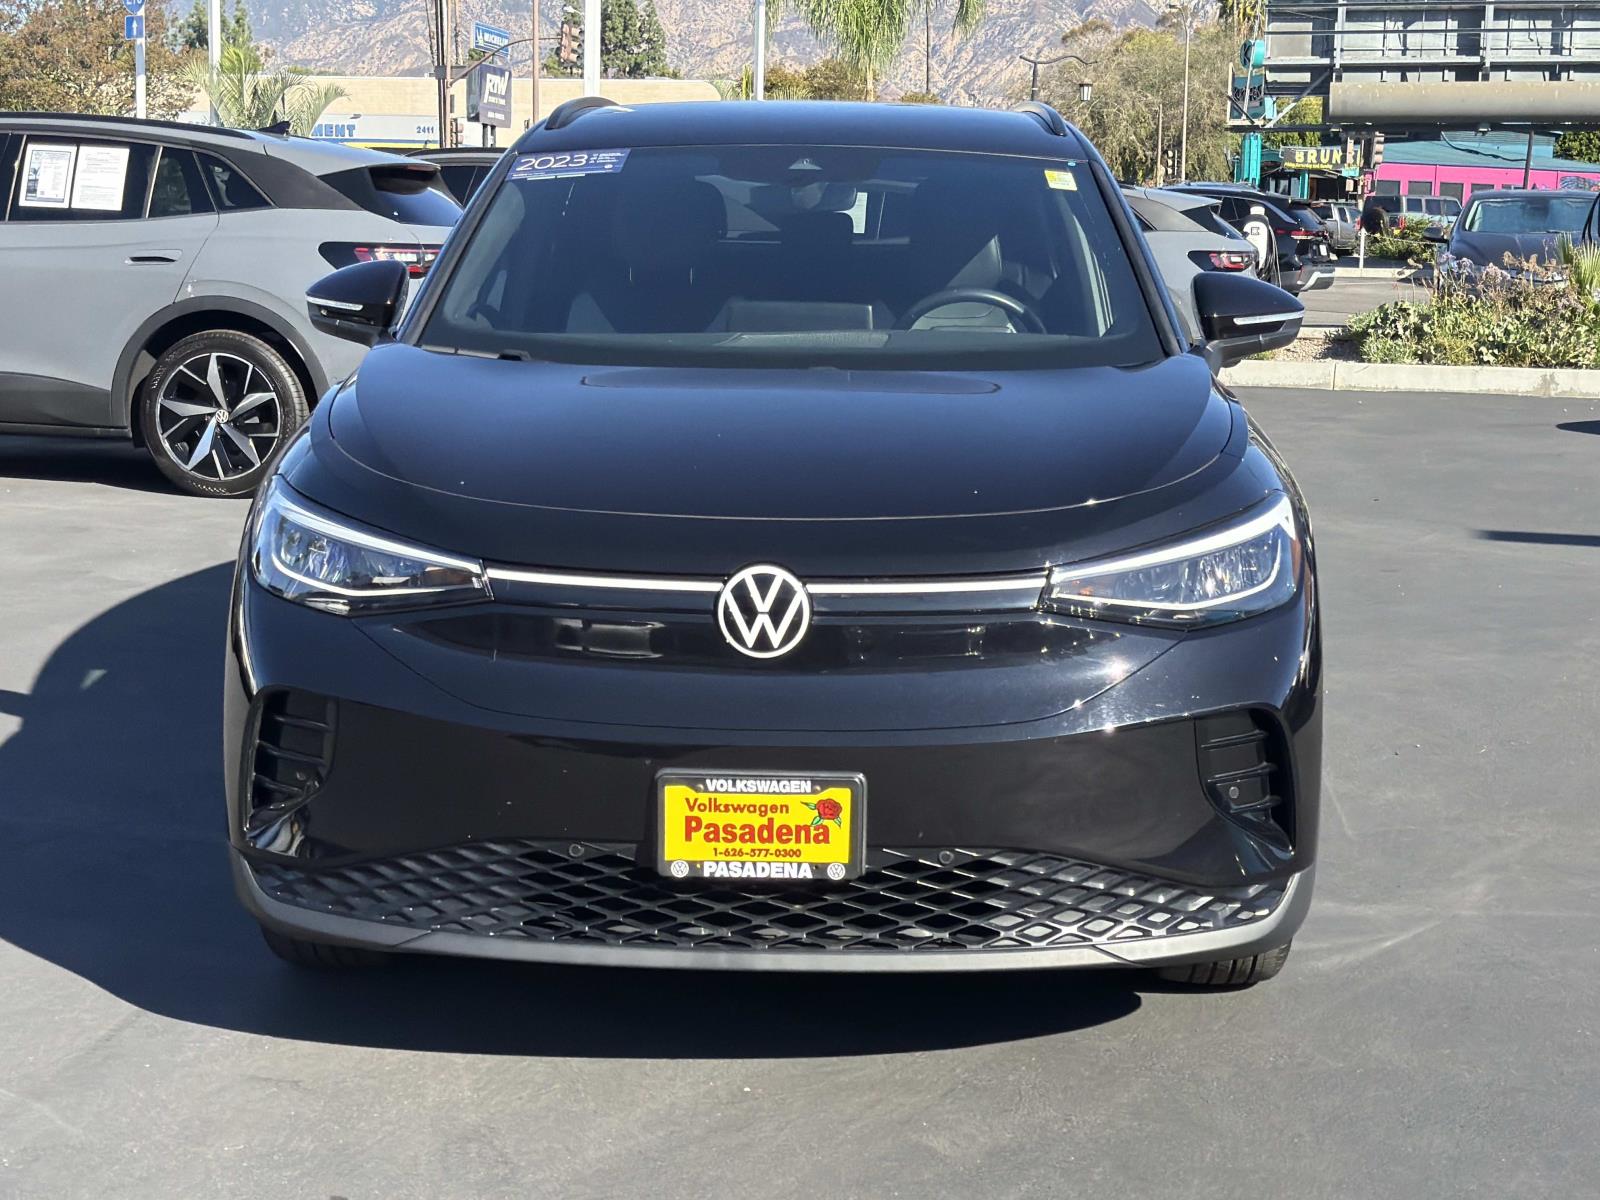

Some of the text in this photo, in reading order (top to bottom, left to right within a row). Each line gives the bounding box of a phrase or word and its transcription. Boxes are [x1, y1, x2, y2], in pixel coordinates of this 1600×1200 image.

[516, 154, 588, 171] 2023
[706, 779, 811, 793] VOLKSWAGEN
[685, 798, 789, 817] Volkswagen
[685, 816, 830, 844] Pasadena
[713, 848, 801, 858] 1-626-577-0300
[703, 861, 814, 878] PASADENA
